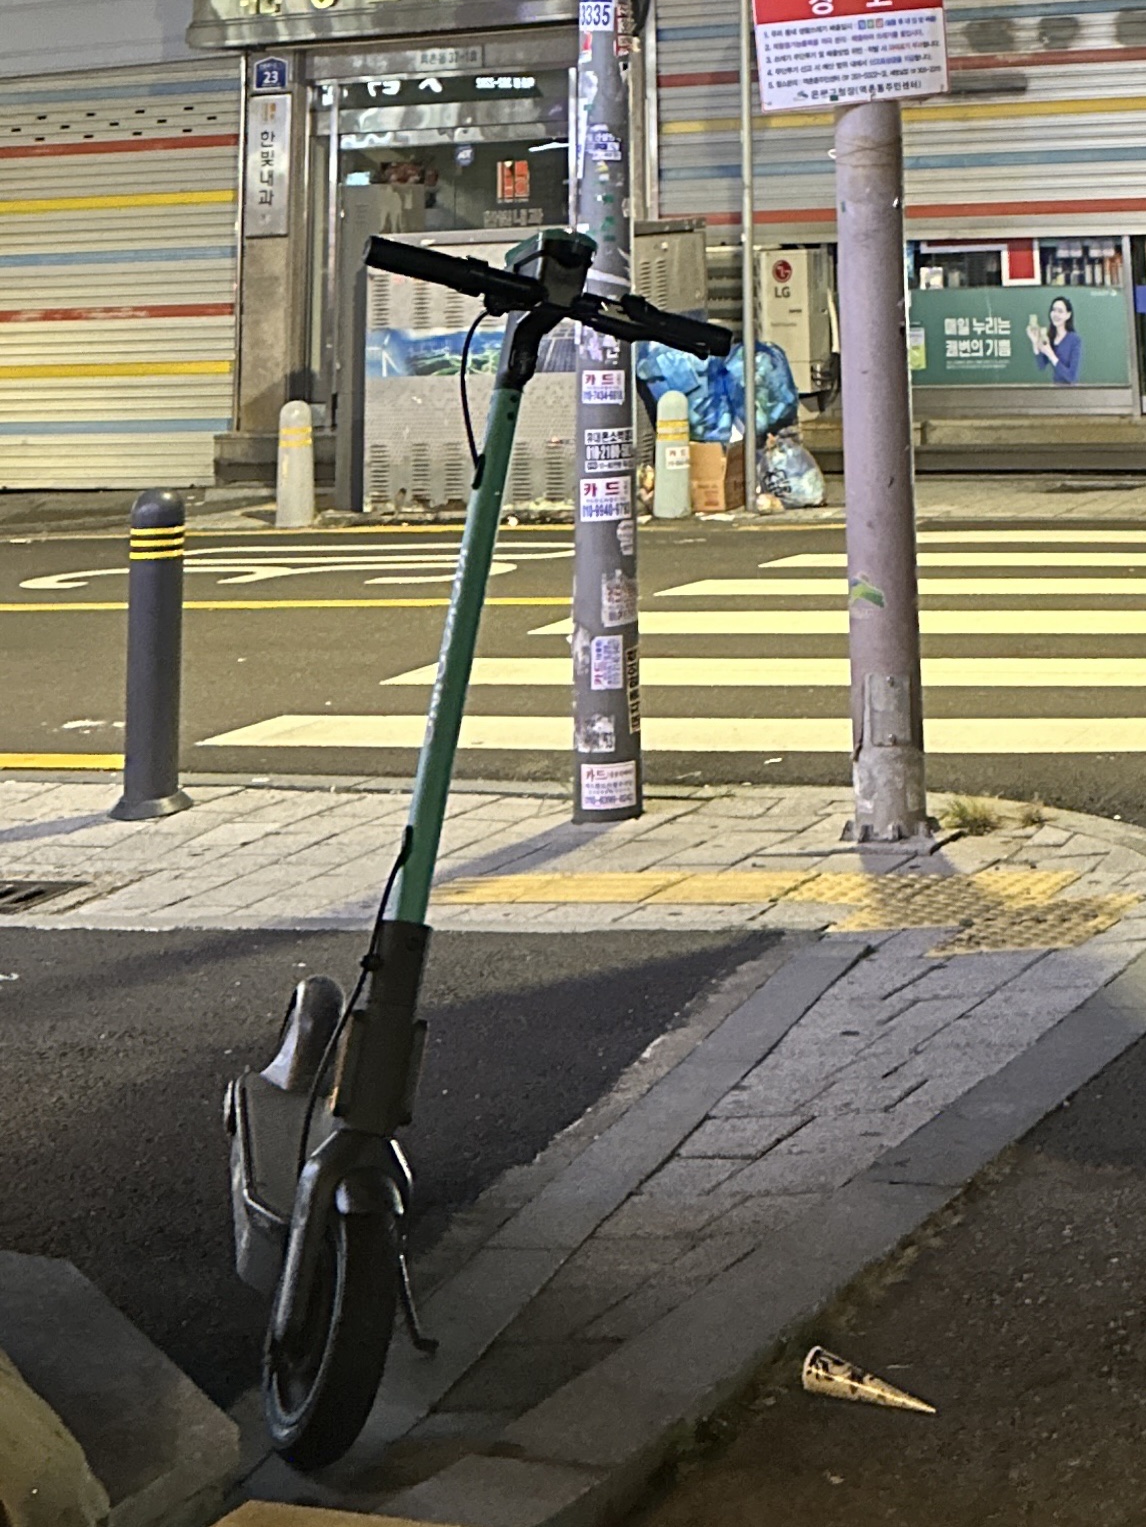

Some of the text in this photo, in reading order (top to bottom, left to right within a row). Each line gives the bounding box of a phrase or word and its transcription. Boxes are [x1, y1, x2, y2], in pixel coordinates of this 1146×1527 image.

[263, 71, 278, 84] 23
[775, 286, 791, 299] LG
[972, 317, 1011, 335] 누리는
[584, 481, 620, 497] 카드
